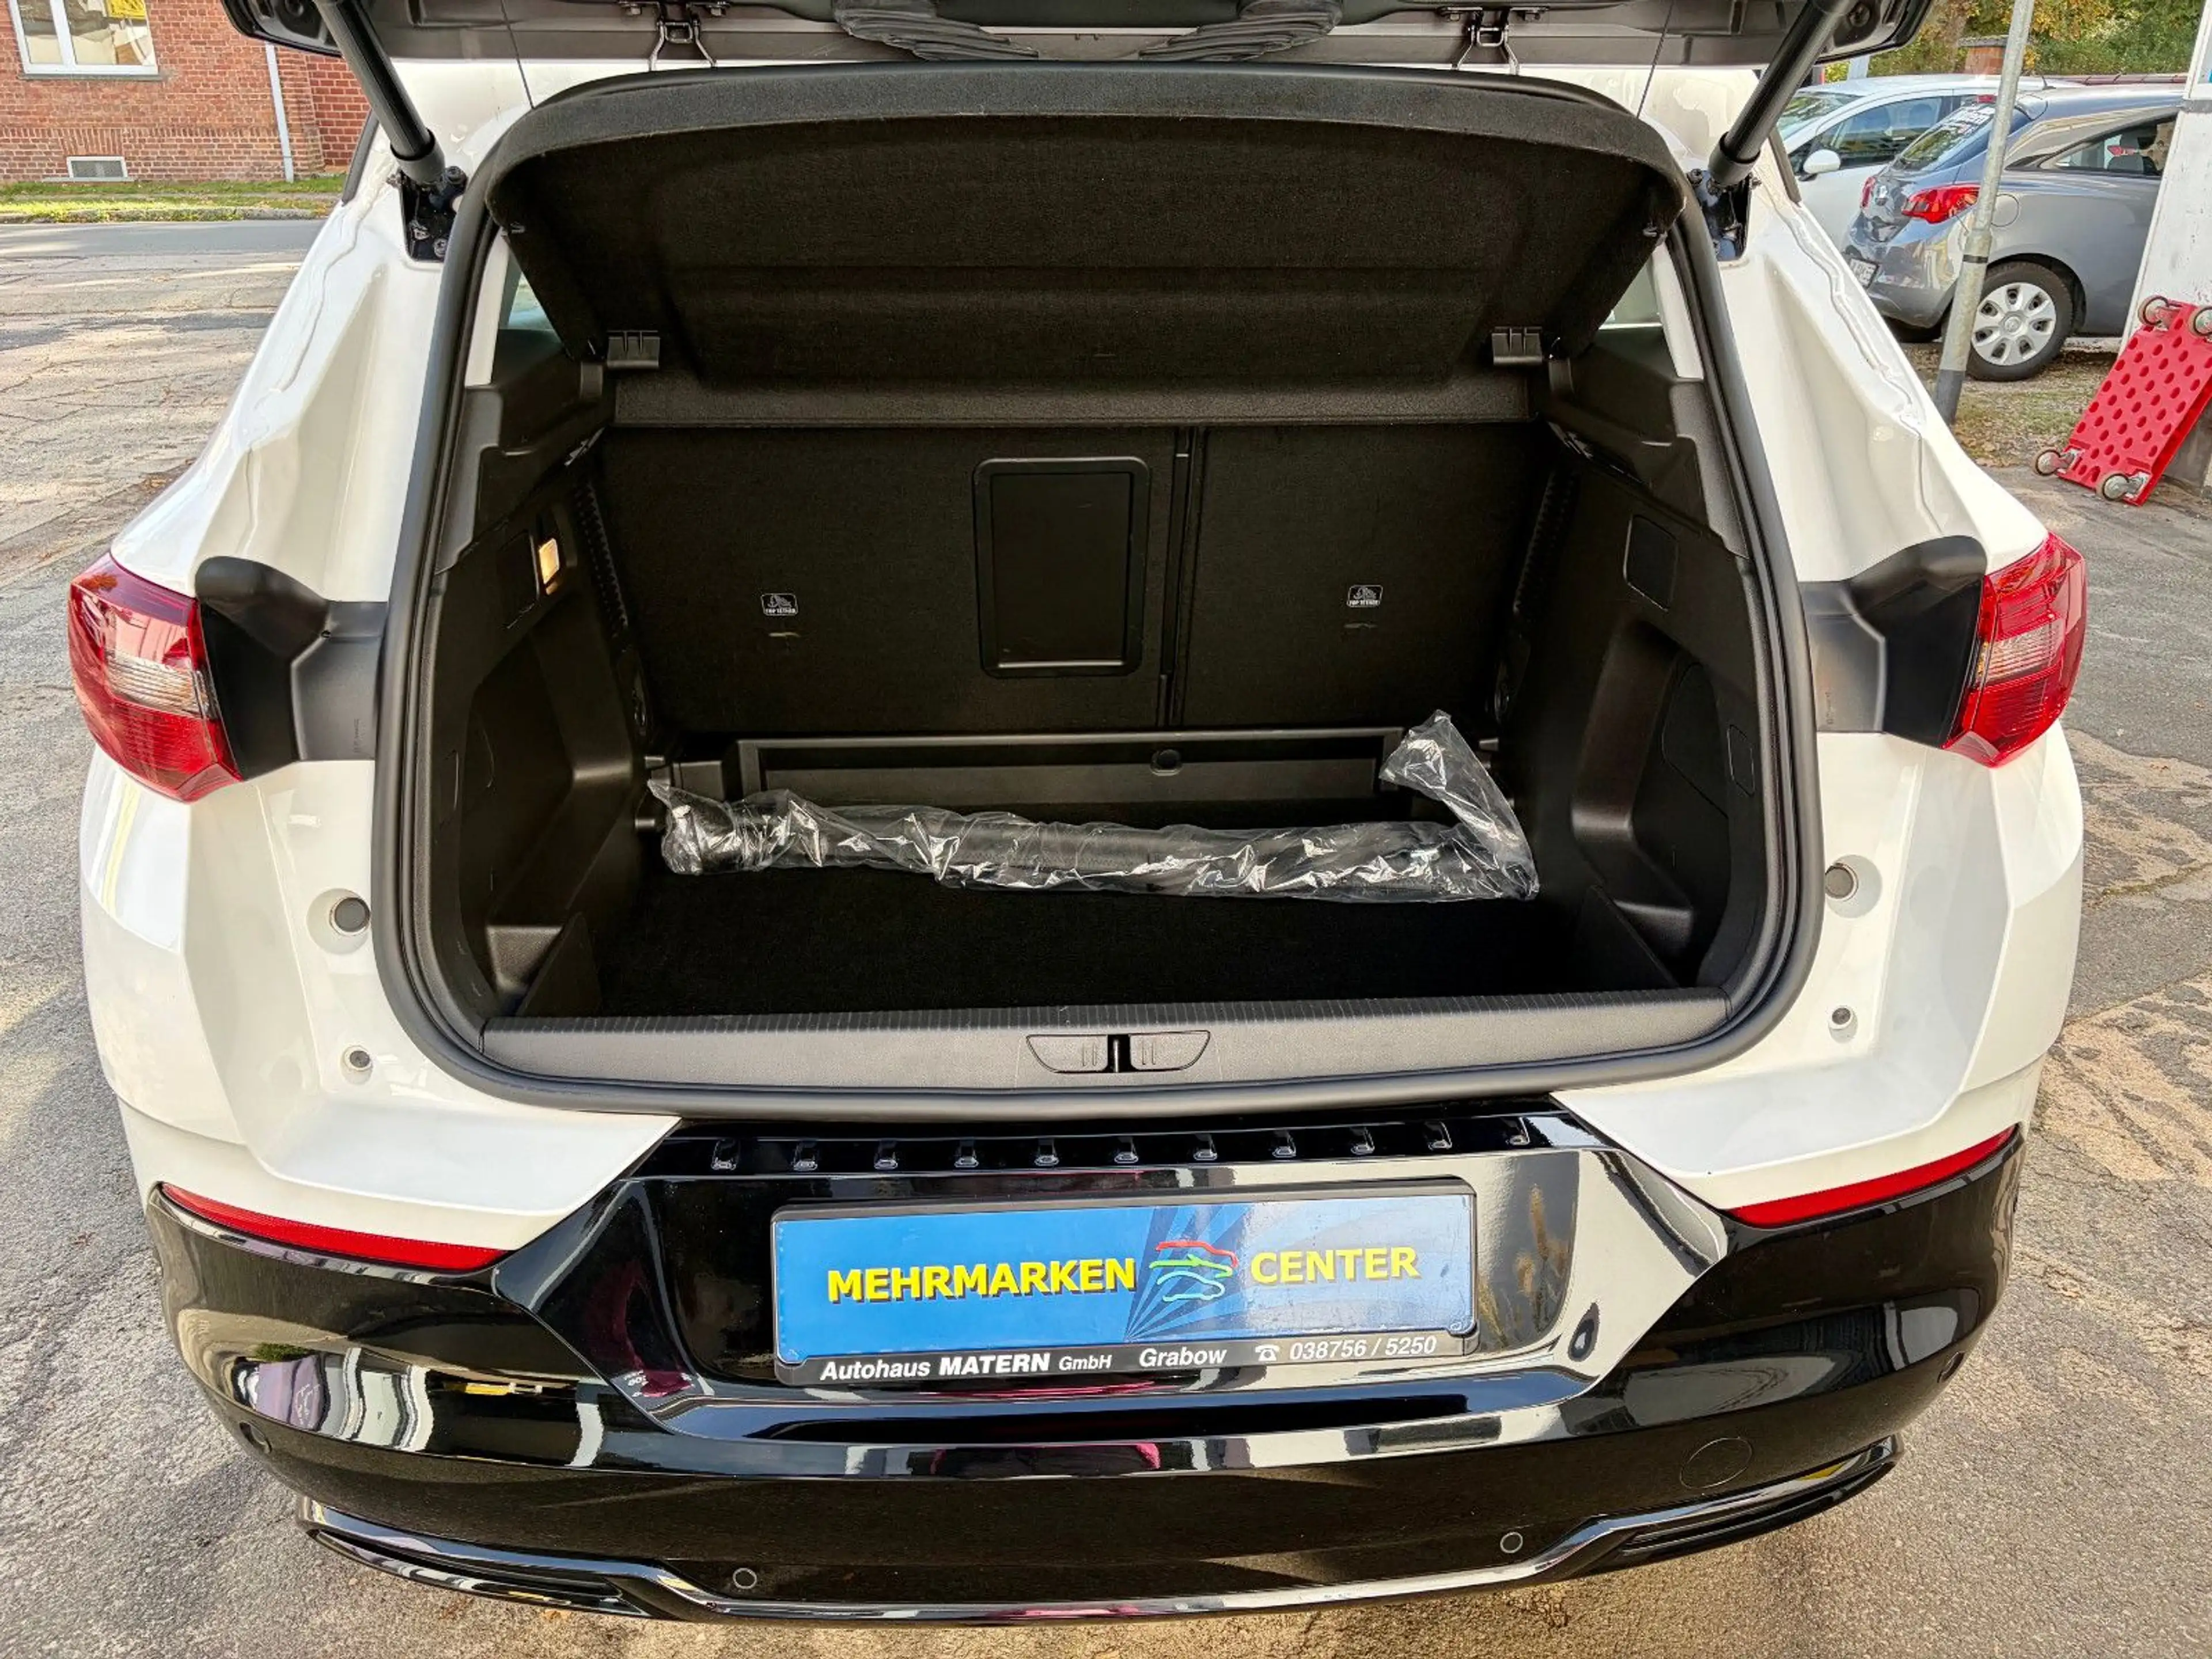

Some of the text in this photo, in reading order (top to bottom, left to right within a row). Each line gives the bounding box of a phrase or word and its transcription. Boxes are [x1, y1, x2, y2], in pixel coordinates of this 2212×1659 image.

[827, 1245, 1422, 1304] MEHRMARKEN CENTER
[820, 1360, 930, 1381] Autohaus
[939, 1353, 1051, 1376] MATERN
[1058, 1354, 1112, 1371] GmbH
[1138, 1346, 1227, 1368] Grabow
[1289, 1339, 1366, 1361] 038756
[1385, 1336, 1437, 1356] 5250
